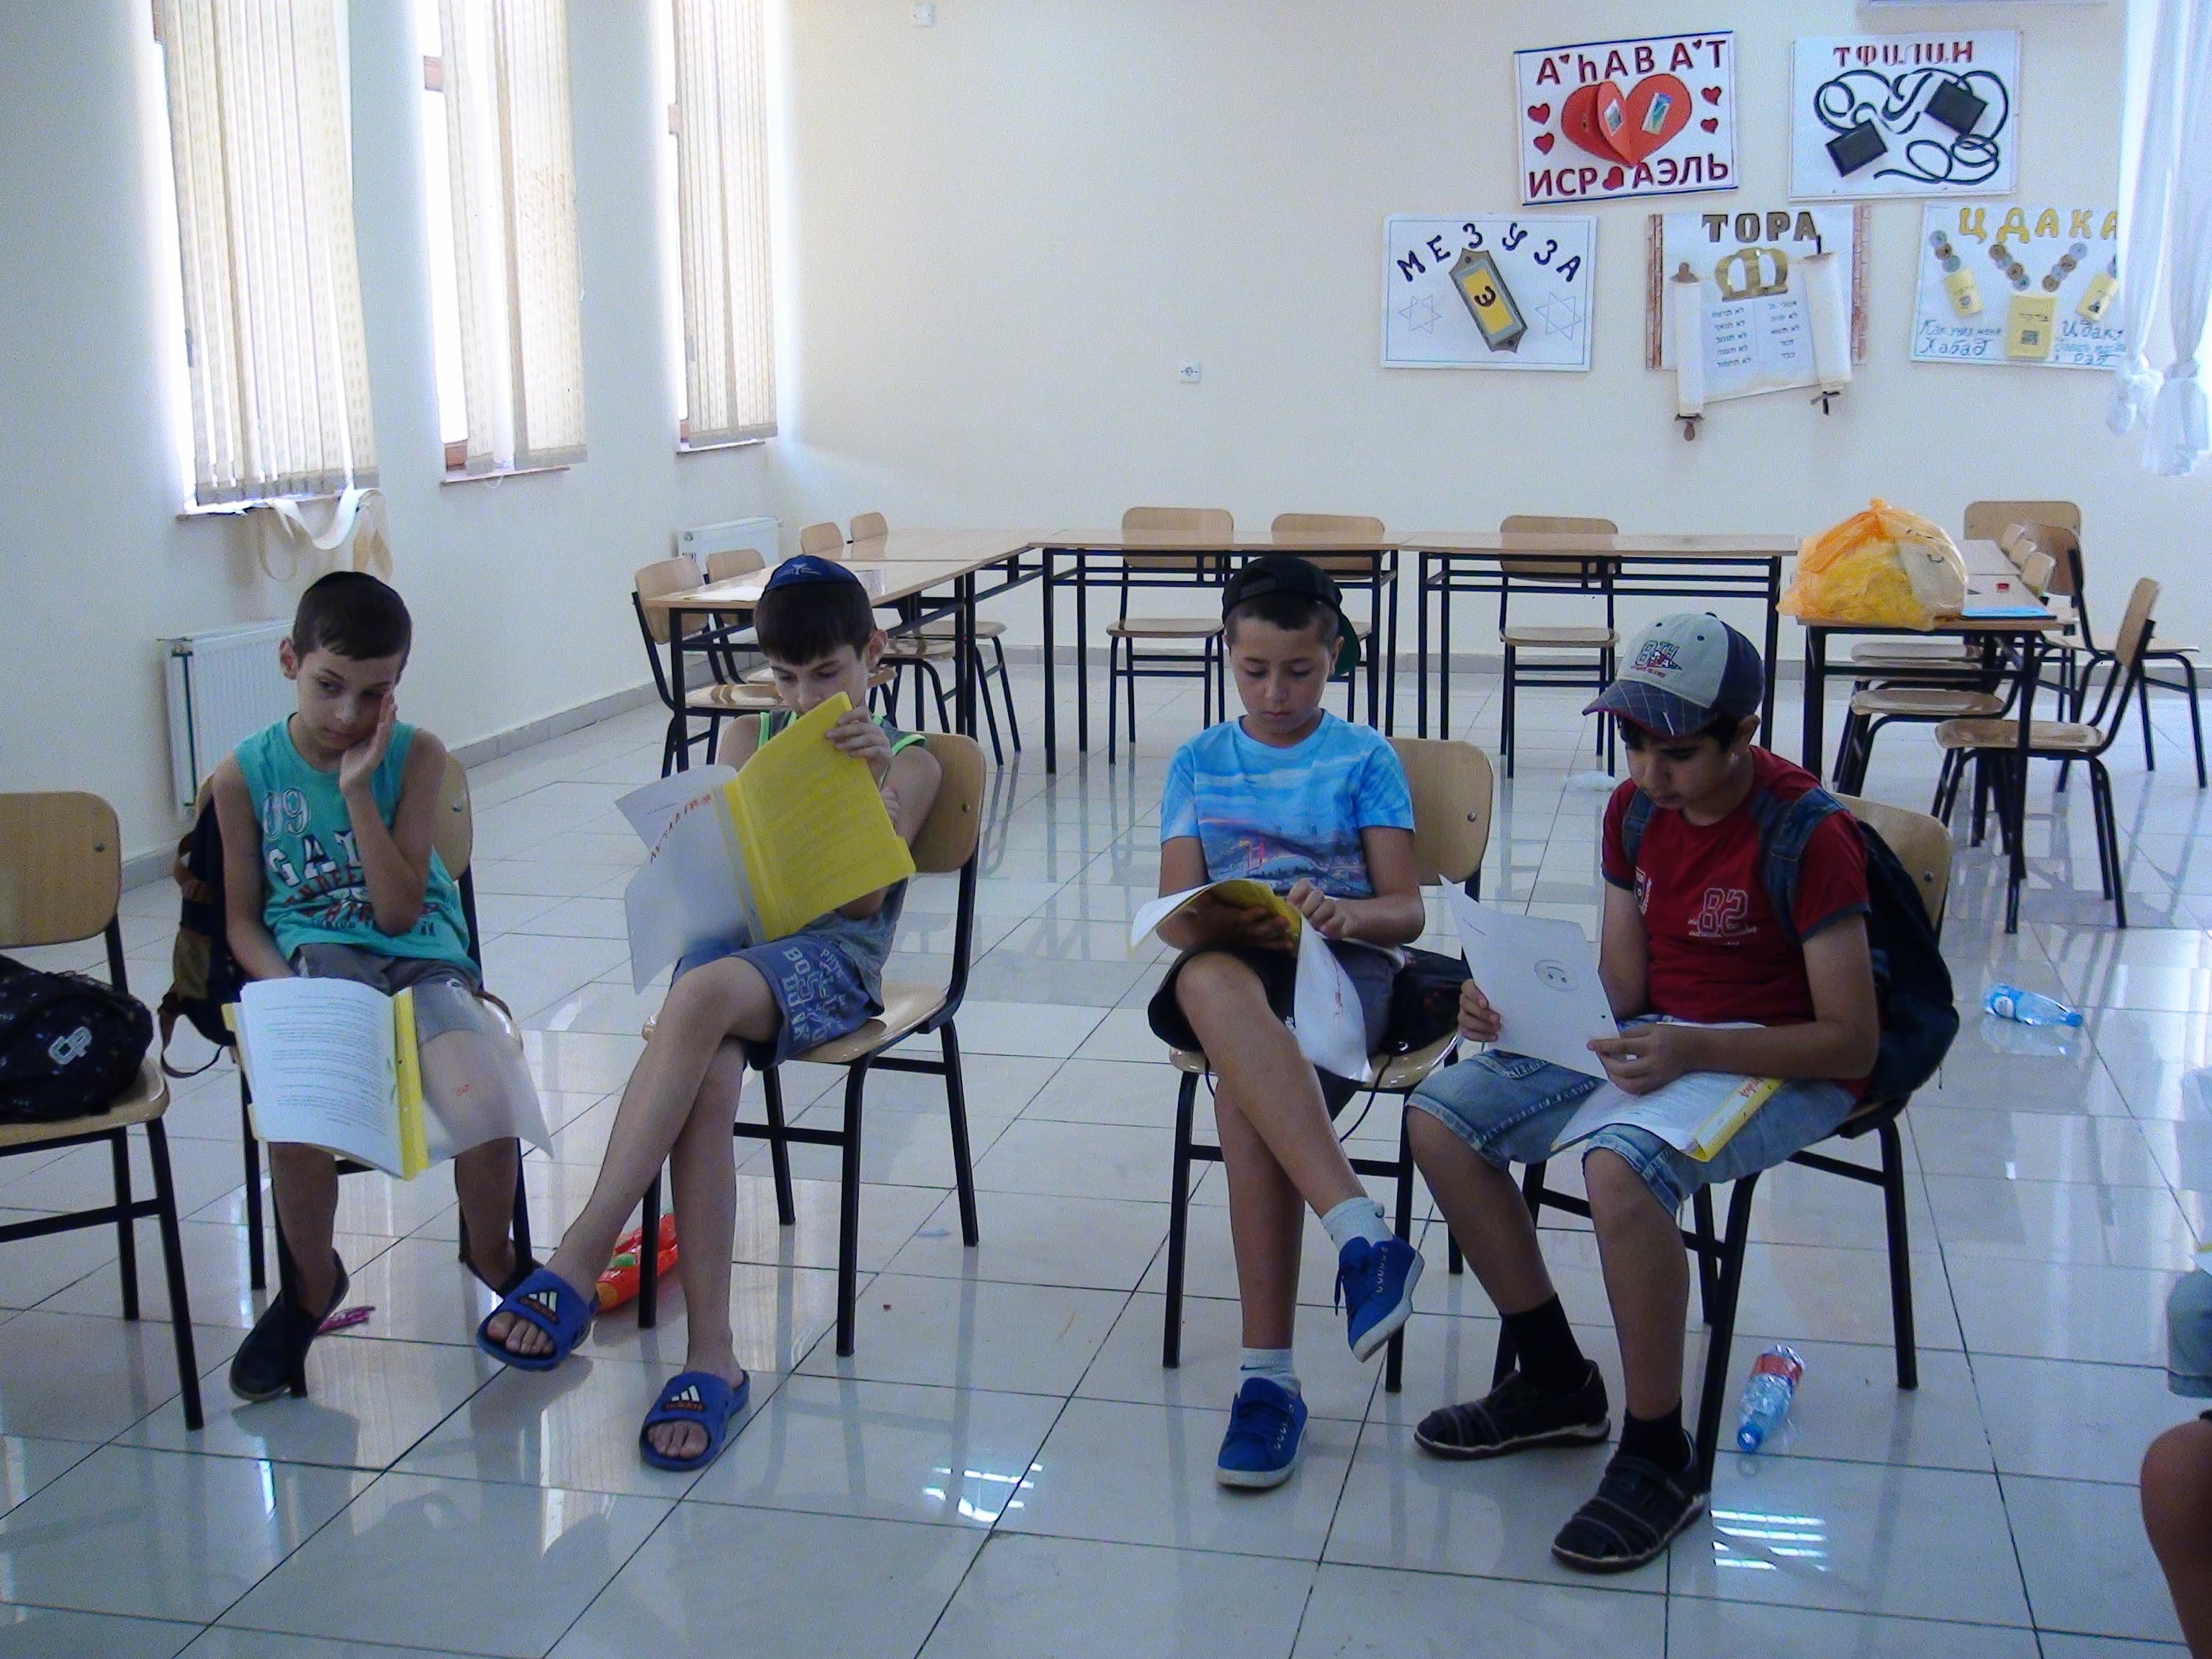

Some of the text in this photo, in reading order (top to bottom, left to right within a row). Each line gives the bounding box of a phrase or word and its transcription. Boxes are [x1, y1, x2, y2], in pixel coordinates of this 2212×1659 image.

[1701, 211, 1819, 243] ТОРА
[1396, 222, 1582, 283] МЕЗУЗА
[1697, 887, 1748, 937] 82
